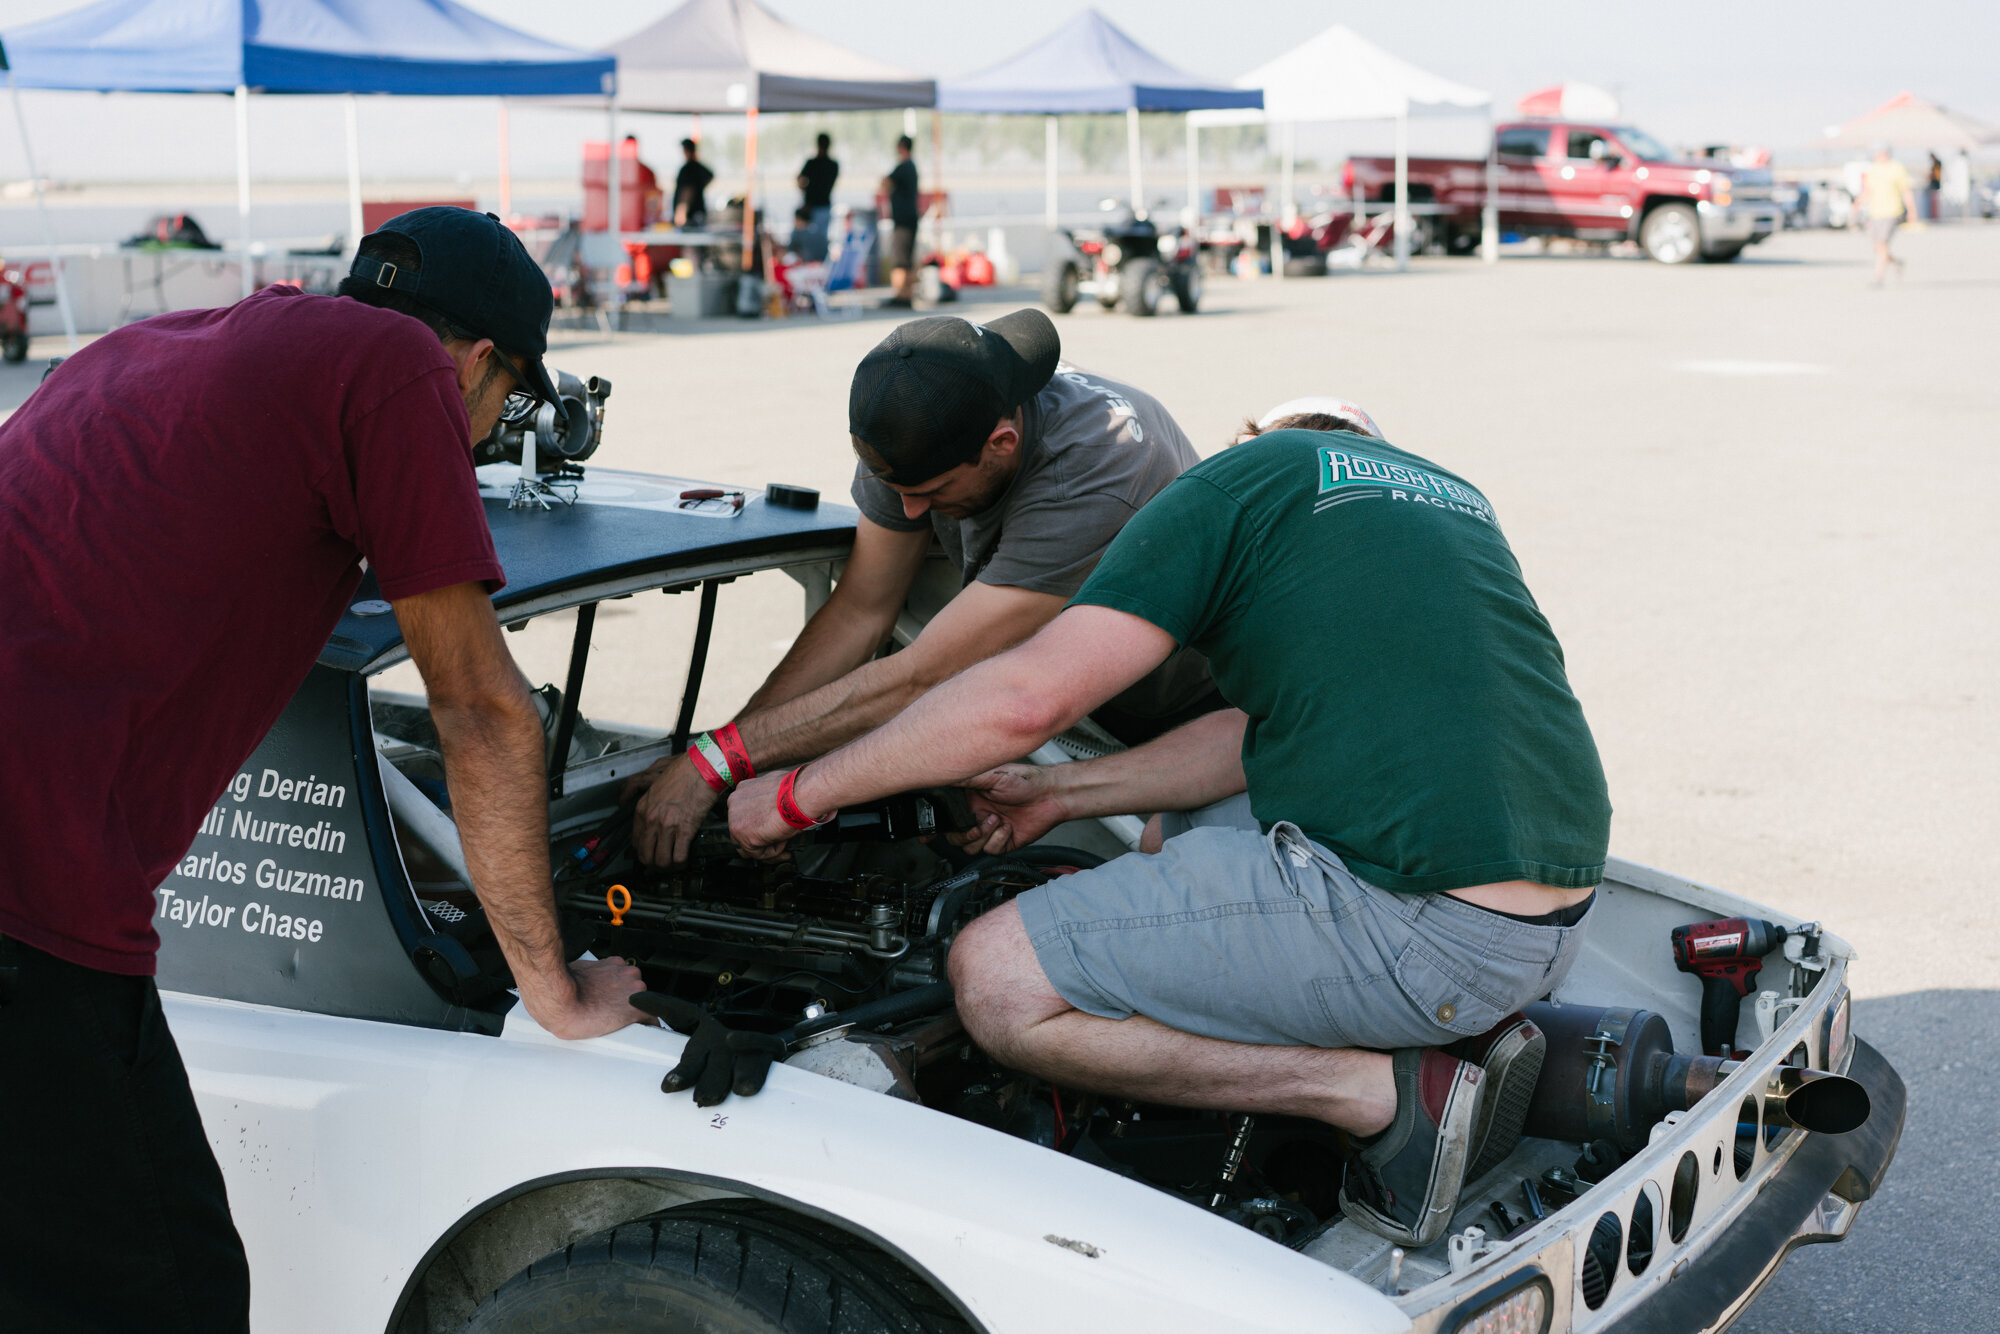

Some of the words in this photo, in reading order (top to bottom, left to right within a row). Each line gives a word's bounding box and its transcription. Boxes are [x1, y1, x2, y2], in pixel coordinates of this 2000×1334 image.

[258, 768, 346, 808] Derian
[230, 809, 346, 854] Nurredin
[175, 851, 247, 885] arlos
[255, 858, 364, 902] Guzman
[159, 888, 235, 928] Taylor
[241, 902, 324, 943] Chase
[711, 1113, 729, 1127] 26
